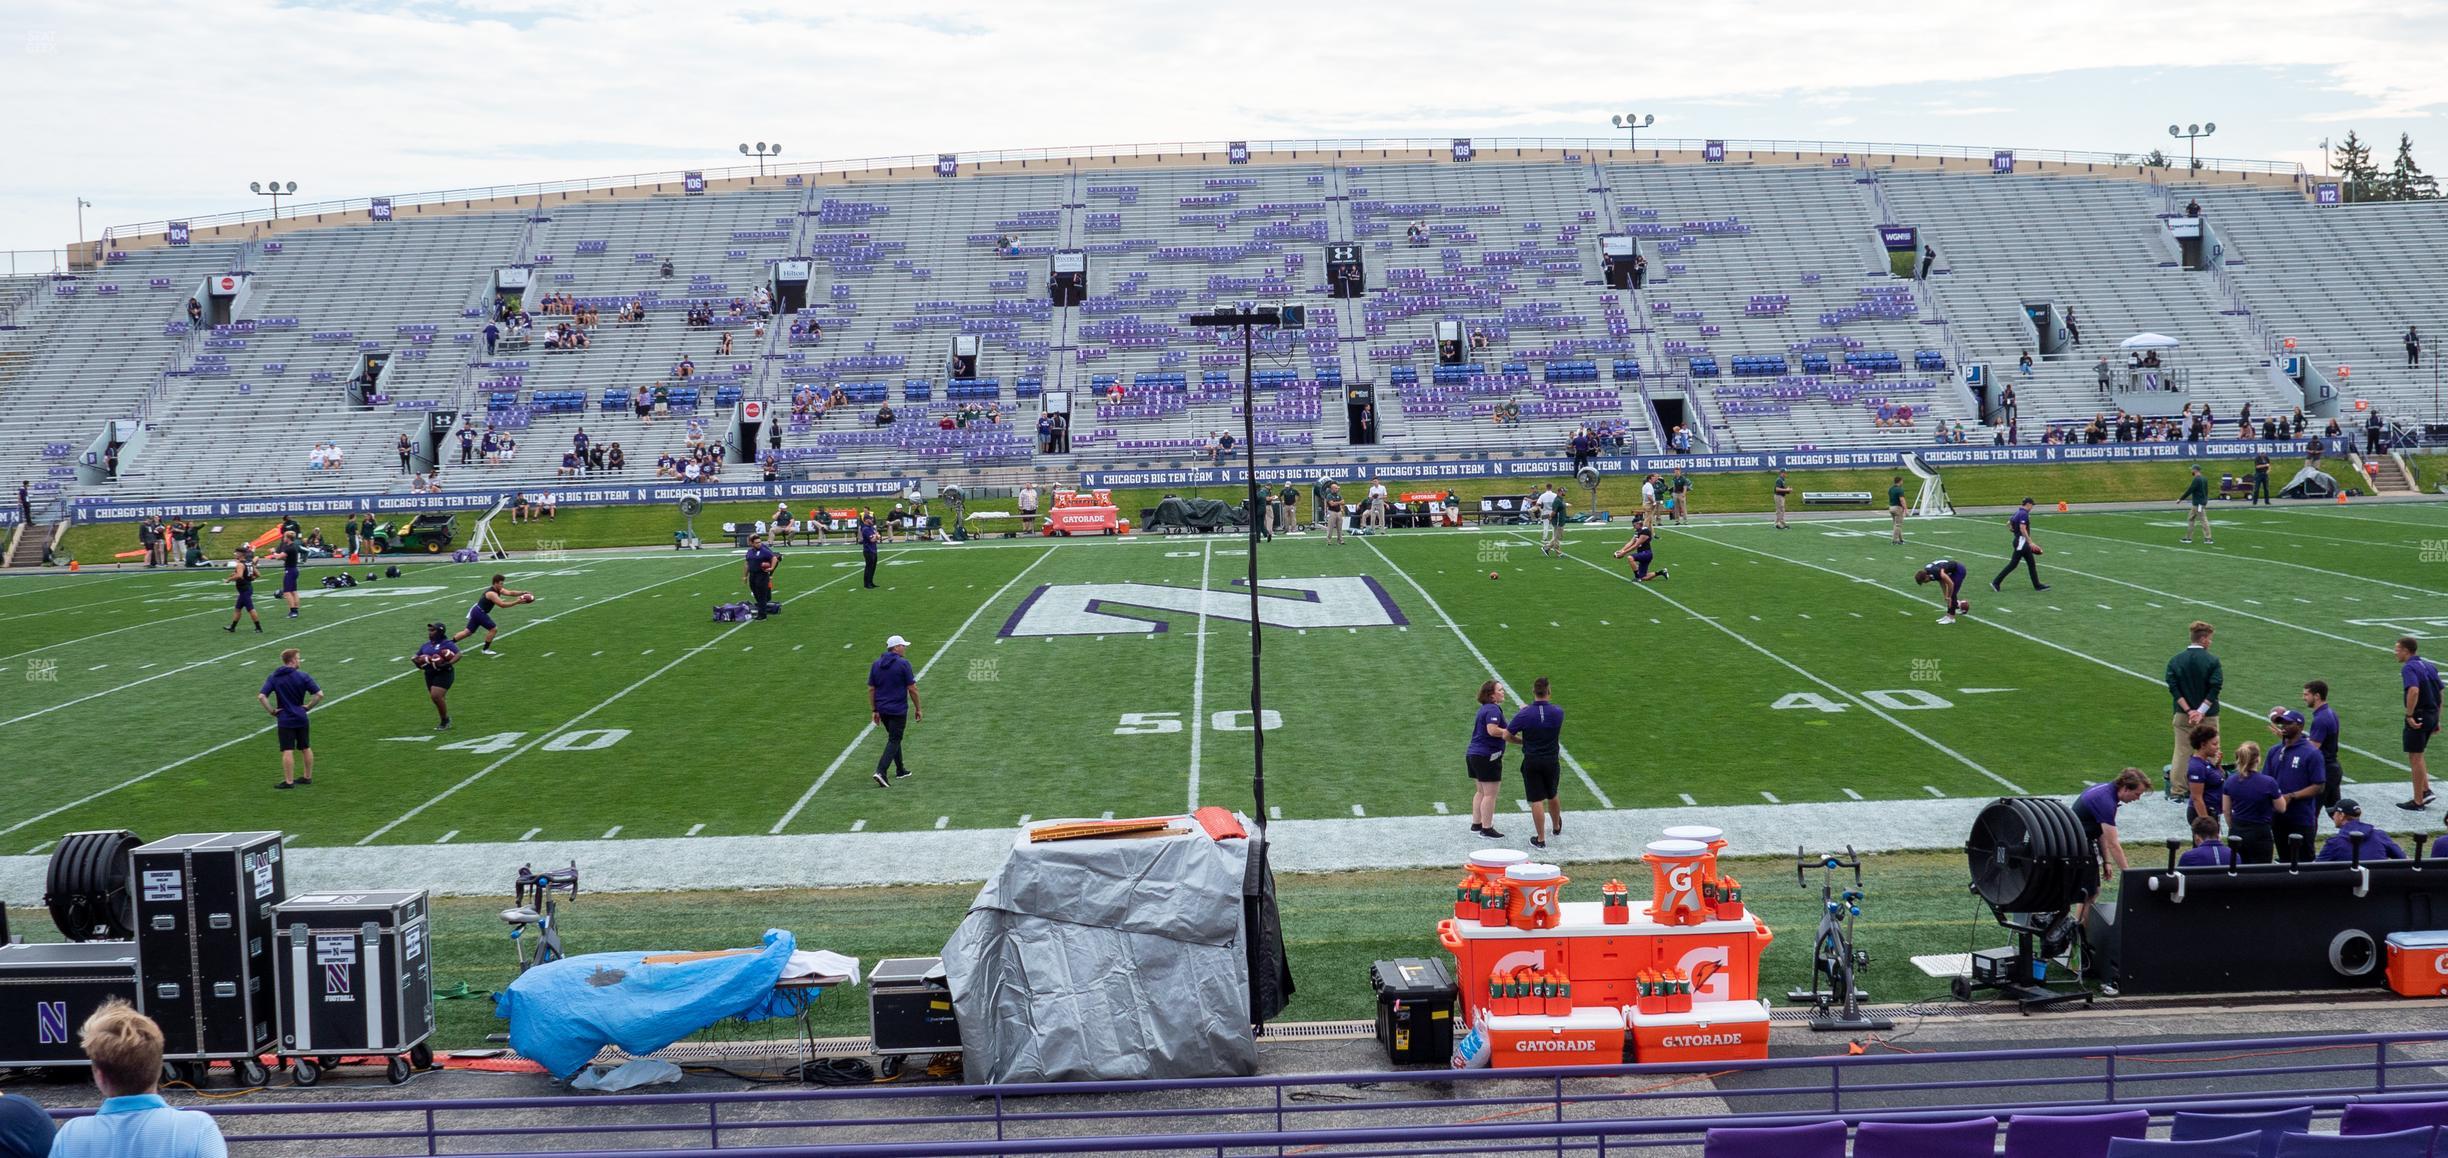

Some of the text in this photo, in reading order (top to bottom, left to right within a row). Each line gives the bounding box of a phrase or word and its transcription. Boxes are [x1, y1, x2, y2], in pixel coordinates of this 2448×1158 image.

[1231, 148, 1246, 159] 108
[1454, 146, 1469, 156] 109
[1709, 147, 1721, 157] 110
[940, 161, 954, 172] 107
[1998, 157, 2010, 168] 111
[686, 178, 702, 189] 106
[2320, 191, 2336, 202] 112
[373, 205, 390, 216] 105
[170, 228, 187, 240] 104
[1886, 233, 1902, 241] WGN
[2189, 444, 2197, 455] N
[2207, 444, 2255, 454] CHICAGO'S
[2275, 443, 2294, 452] TEN
[2296, 443, 2307, 452] TE
[2333, 441, 2341, 451] N
[1925, 450, 2037, 461] CHICAGO'S BIG TEN TEAM
[2047, 446, 2178, 459] N CHICAGO'S BIG TEN TEAM
[1631, 457, 1758, 470] N CHICAGO'S BIG TEN TEAM
[1768, 453, 1897, 466] N CHICAGO'S BIG TEN TEAM
[1358, 465, 1484, 477] N CHICAGO'S BIG TEN TEAM
[1494, 463, 1502, 473] N
[1512, 463, 1557, 472] CHICAGO'S
[1559, 462, 1574, 471] BIG
[1597, 461, 1621, 470] TEAM
[1087, 472, 1213, 485] N CHICAGO'S BIG TEN TEAM
[1222, 471, 1229, 481] N
[1287, 469, 1302, 479] BIG
[1304, 469, 1321, 478] TEN
[1324, 468, 1348, 477] TEAM
[638, 489, 646, 500] N
[703, 488, 718, 497] BIG
[721, 487, 738, 496] TEN
[741, 486, 765, 495] TEAM
[775, 482, 900, 495] N CHICAGO'S BIG TEN TEAM
[566, 492, 581, 501] BIG
[584, 492, 601, 500] TEN
[604, 491, 629, 500] TEAM
[221, 500, 352, 514] N CHICAGO'S BIG TEN TEAM
[362, 499, 369, 509] N
[379, 498, 426, 508] CHICAGO'S
[428, 497, 443, 506] BIG
[446, 496, 464, 506] TEN
[466, 496, 491, 505] TEAM
[78, 505, 211, 519] N CHICAGO'S BIG TEN TEAM
[1062, 515, 1105, 523] GATORADE
[1669, 867, 1692, 891] G
[1532, 889, 1546, 906] G
[326, 963, 350, 993] N
[1677, 946, 1729, 1001] G
[1534, 987, 1541, 995] G
[325, 994, 356, 1002] FOOTBALL
[37, 1001, 68, 1044] N
[1516, 1040, 1595, 1051] GATORADE
[1662, 1033, 1742, 1047] GATORADE
